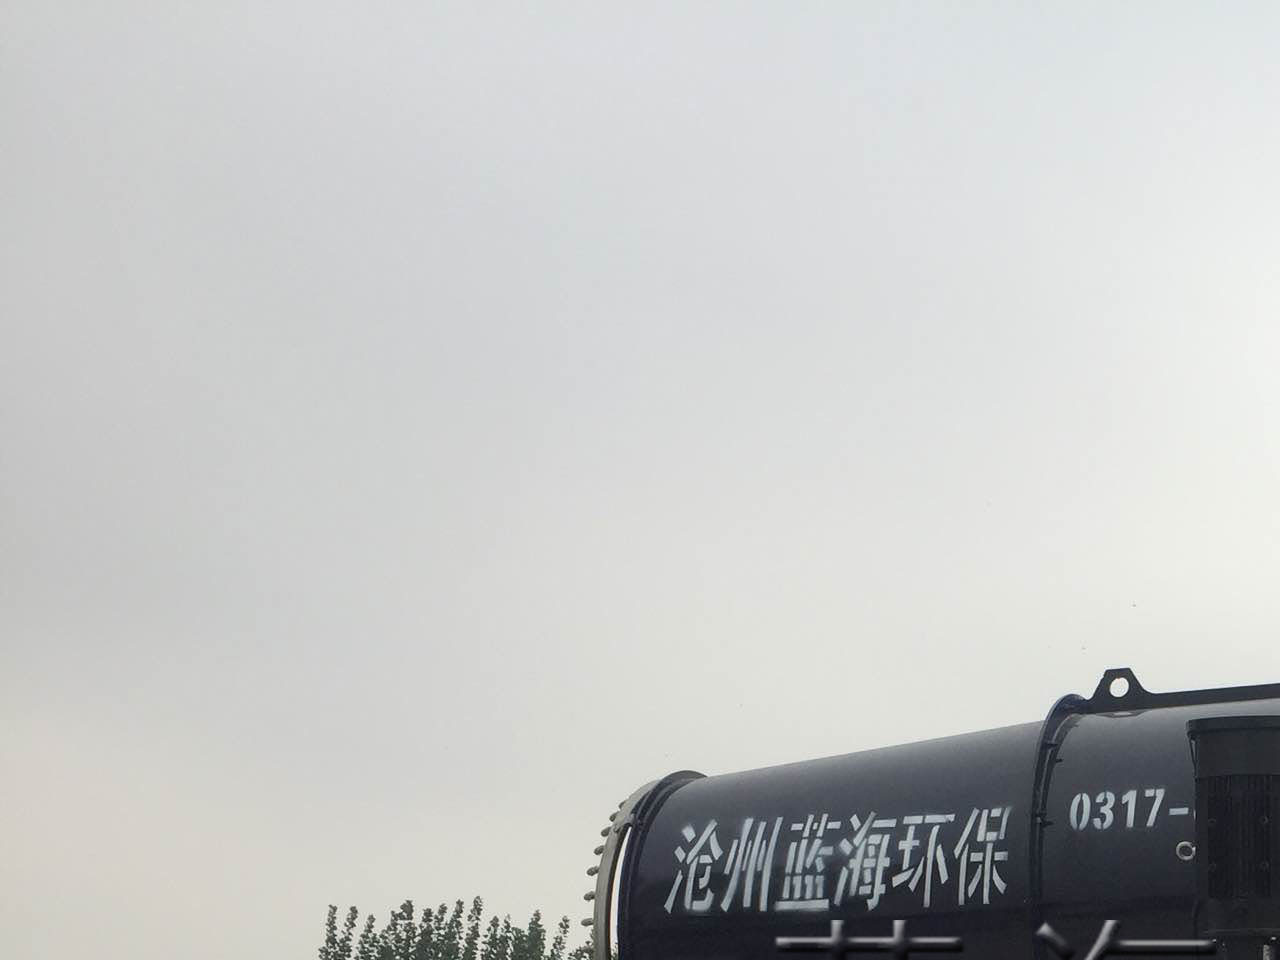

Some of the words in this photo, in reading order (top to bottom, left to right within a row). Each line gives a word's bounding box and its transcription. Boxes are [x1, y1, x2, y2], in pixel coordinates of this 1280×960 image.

[664, 806, 1011, 914] 沧州蓝海环保
